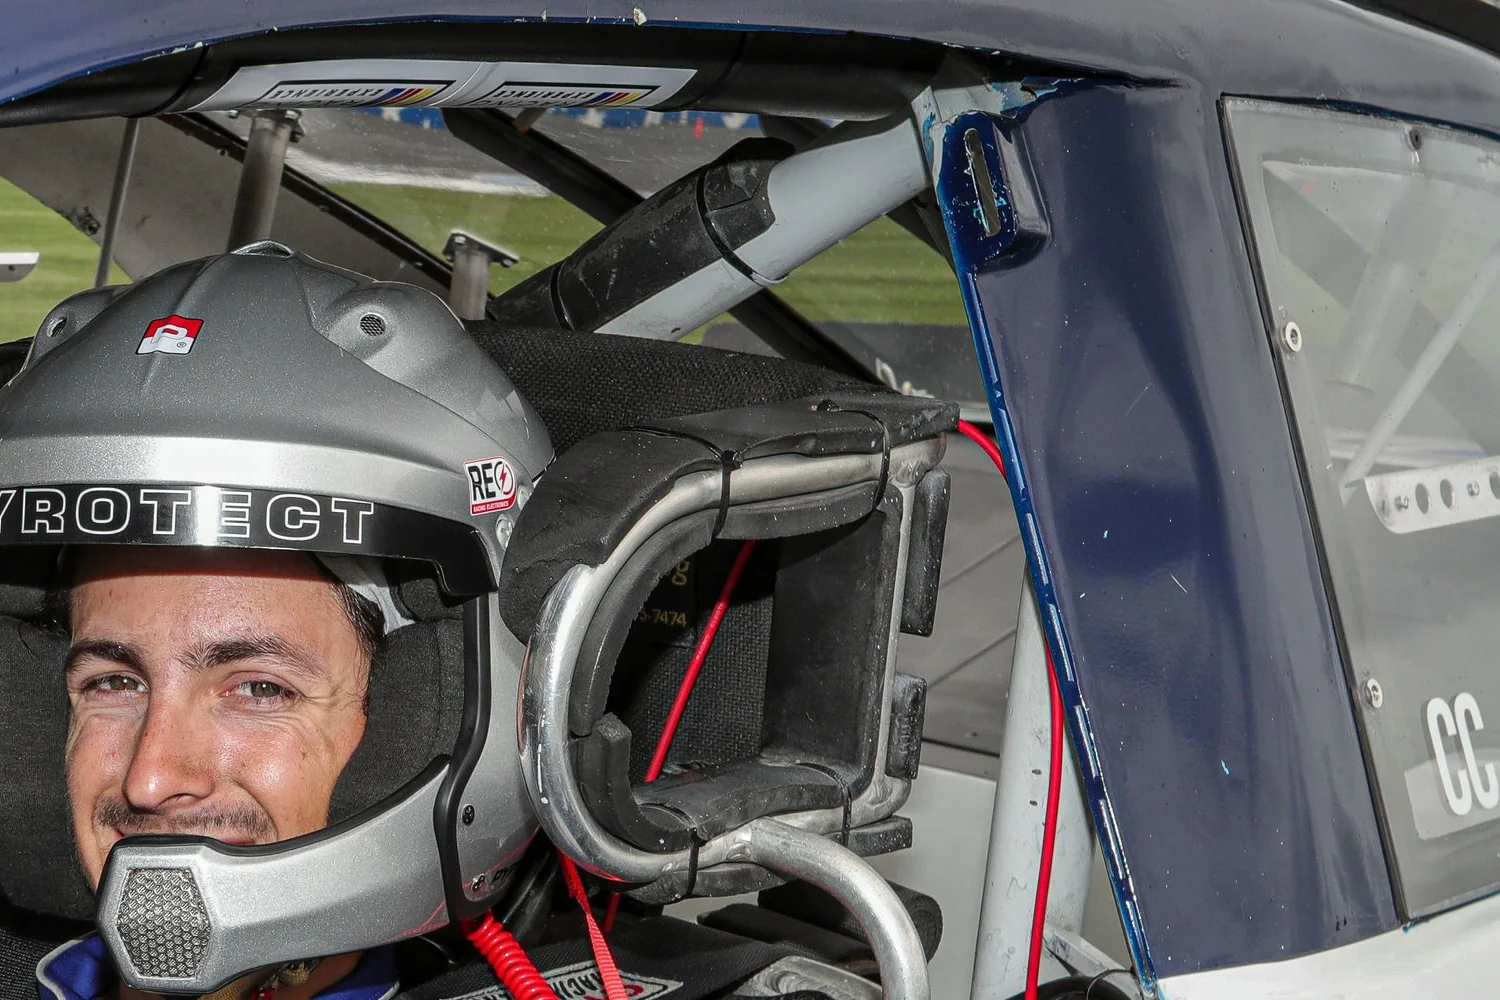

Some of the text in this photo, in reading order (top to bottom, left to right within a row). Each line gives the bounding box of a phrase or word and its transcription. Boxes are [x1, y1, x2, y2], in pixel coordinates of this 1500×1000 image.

[269, 88, 386, 100] EXPERIENCE
[493, 90, 596, 99] EXPERIENCE
[1426, 692, 1499, 816] CC
